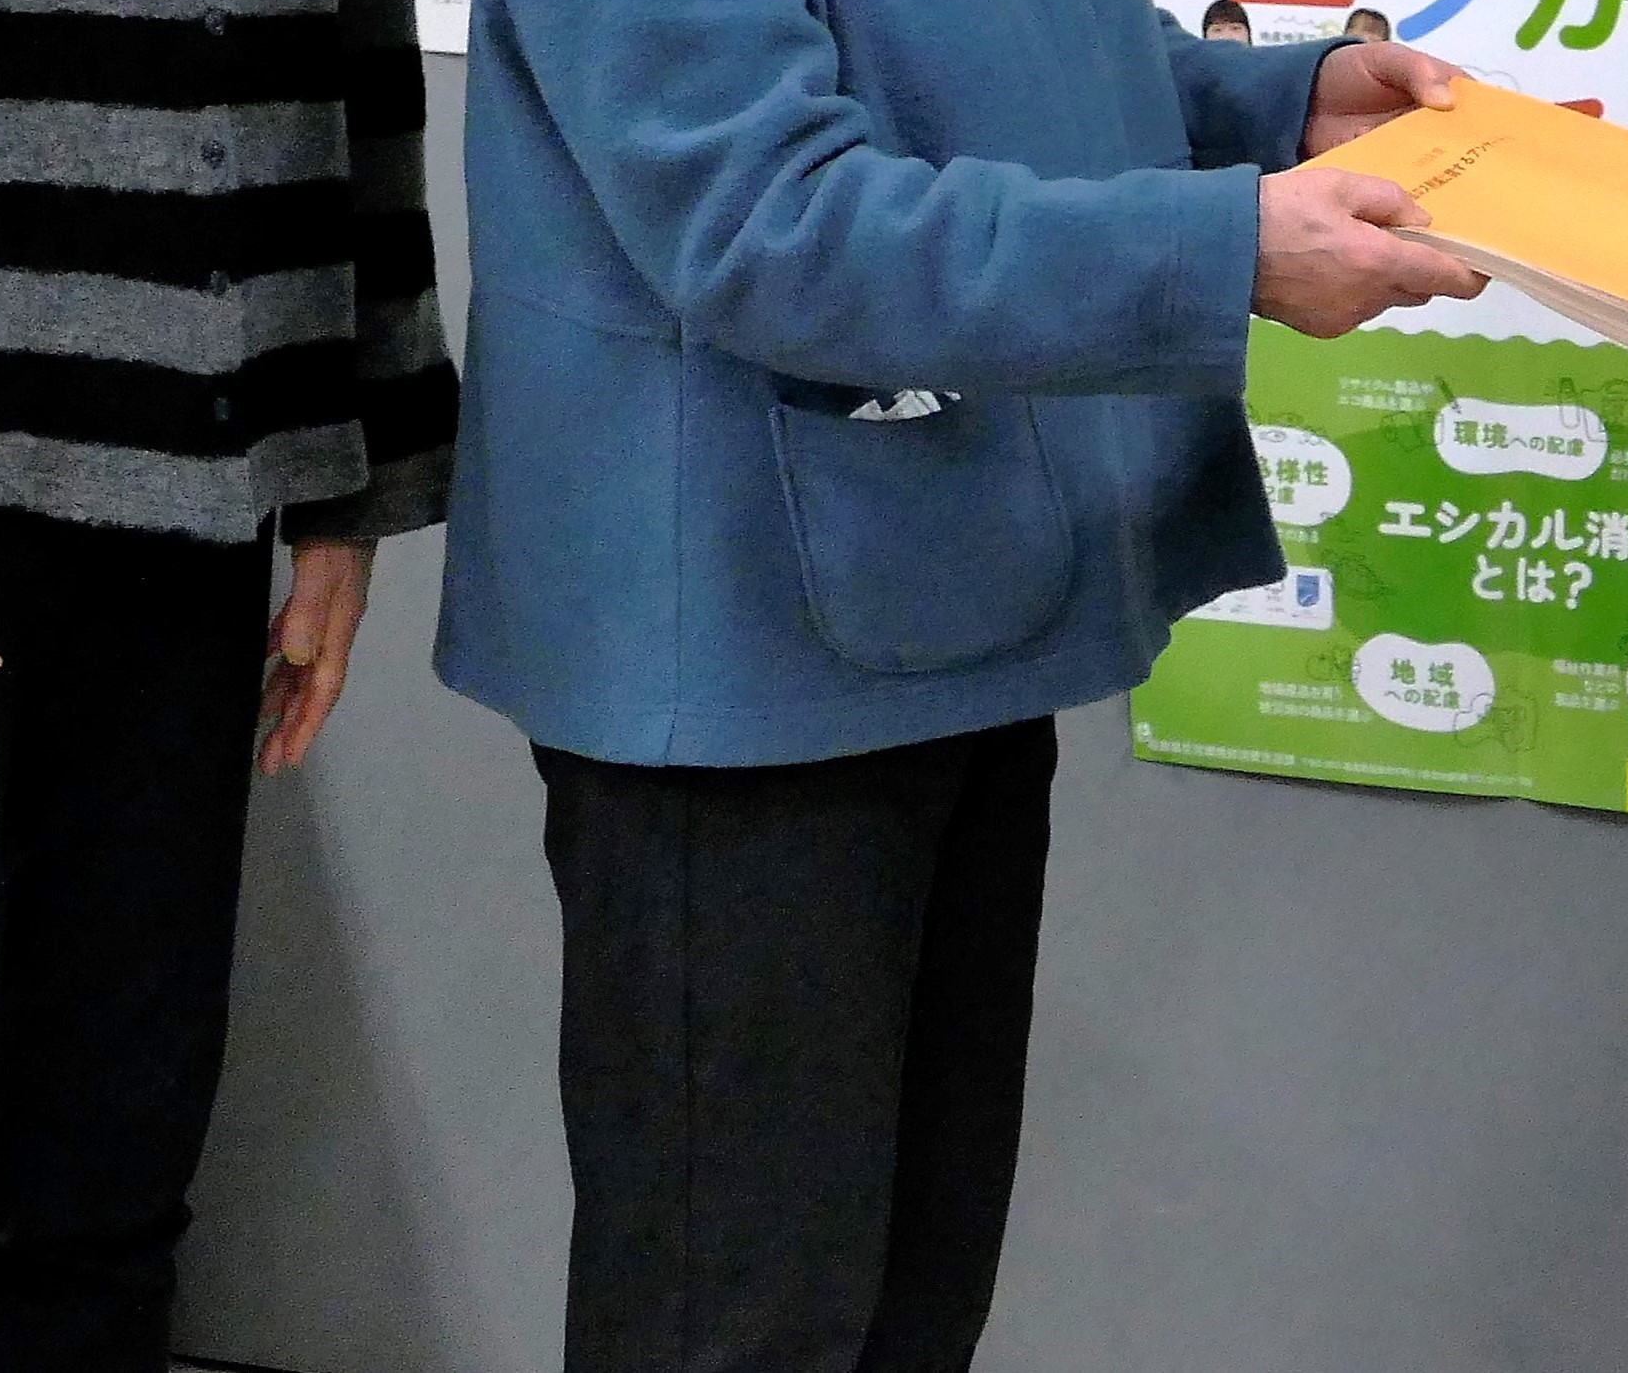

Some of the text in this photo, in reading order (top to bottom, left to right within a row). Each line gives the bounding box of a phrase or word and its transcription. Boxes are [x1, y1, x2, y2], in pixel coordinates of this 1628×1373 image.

[1454, 421, 1585, 458] 環境への配慮
[1472, 555, 1594, 610] とは？
[1391, 657, 1455, 688] 地域
[1384, 689, 1461, 710] への配慮
